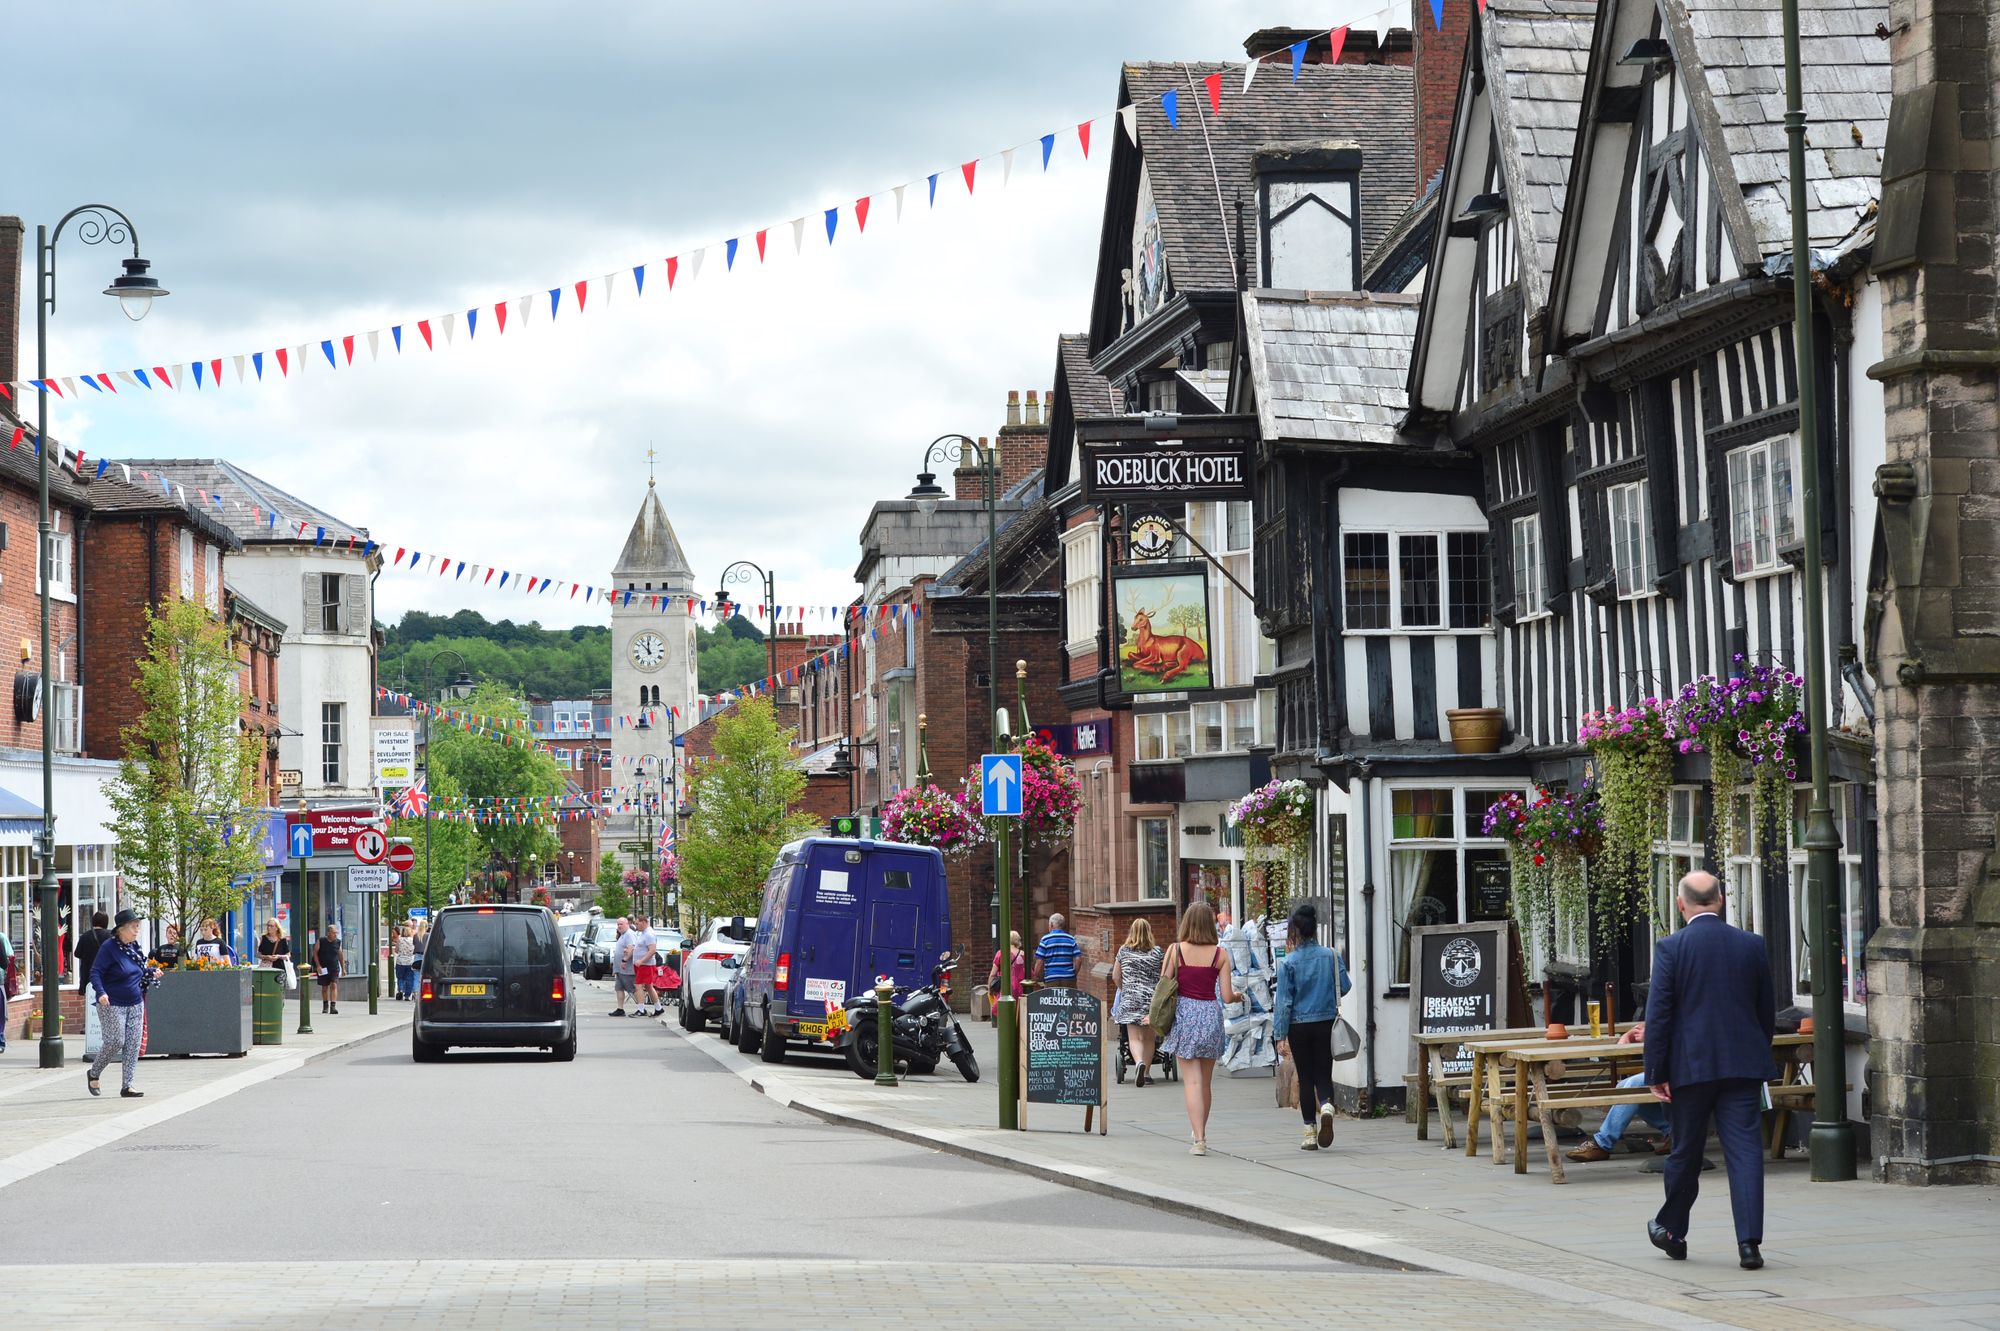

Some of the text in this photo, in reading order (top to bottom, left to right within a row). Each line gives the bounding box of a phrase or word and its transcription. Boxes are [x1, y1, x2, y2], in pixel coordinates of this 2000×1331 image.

[1096, 457, 1243, 485] ROEBUCK HOTEL
[1132, 515, 1171, 530] TITANIC
[1133, 543, 1170, 557] BREWERY
[1077, 724, 1097, 750] NatWest
[321, 815, 351, 823] Welcome
[311, 828, 327, 836] your
[327, 826, 348, 835] Derby
[331, 837, 349, 845] Store
[1442, 940, 1467, 956] WELCOME
[1456, 969, 1480, 986] ROEBUCK
[453, 985, 483, 993] T7 OLX
[1052, 988, 1069, 998] THE
[830, 1001, 839, 1012] L
[1040, 997, 1073, 1006] ROEBUCK
[1428, 996, 1482, 1008] BREAKFAST
[1427, 1006, 1465, 1018] SERVED
[1028, 1013, 1057, 1022] TOTALLY
[800, 1024, 823, 1033] KH06
[1029, 1022, 1054, 1032] LOCALLY
[1446, 1025, 1475, 1033] SERVED
[1030, 1031, 1047, 1041] LEEK
[1030, 1039, 1060, 1051] BURGER
[1063, 1069, 1095, 1081] SUNDAY
[1064, 1079, 1088, 1089] ROAST
